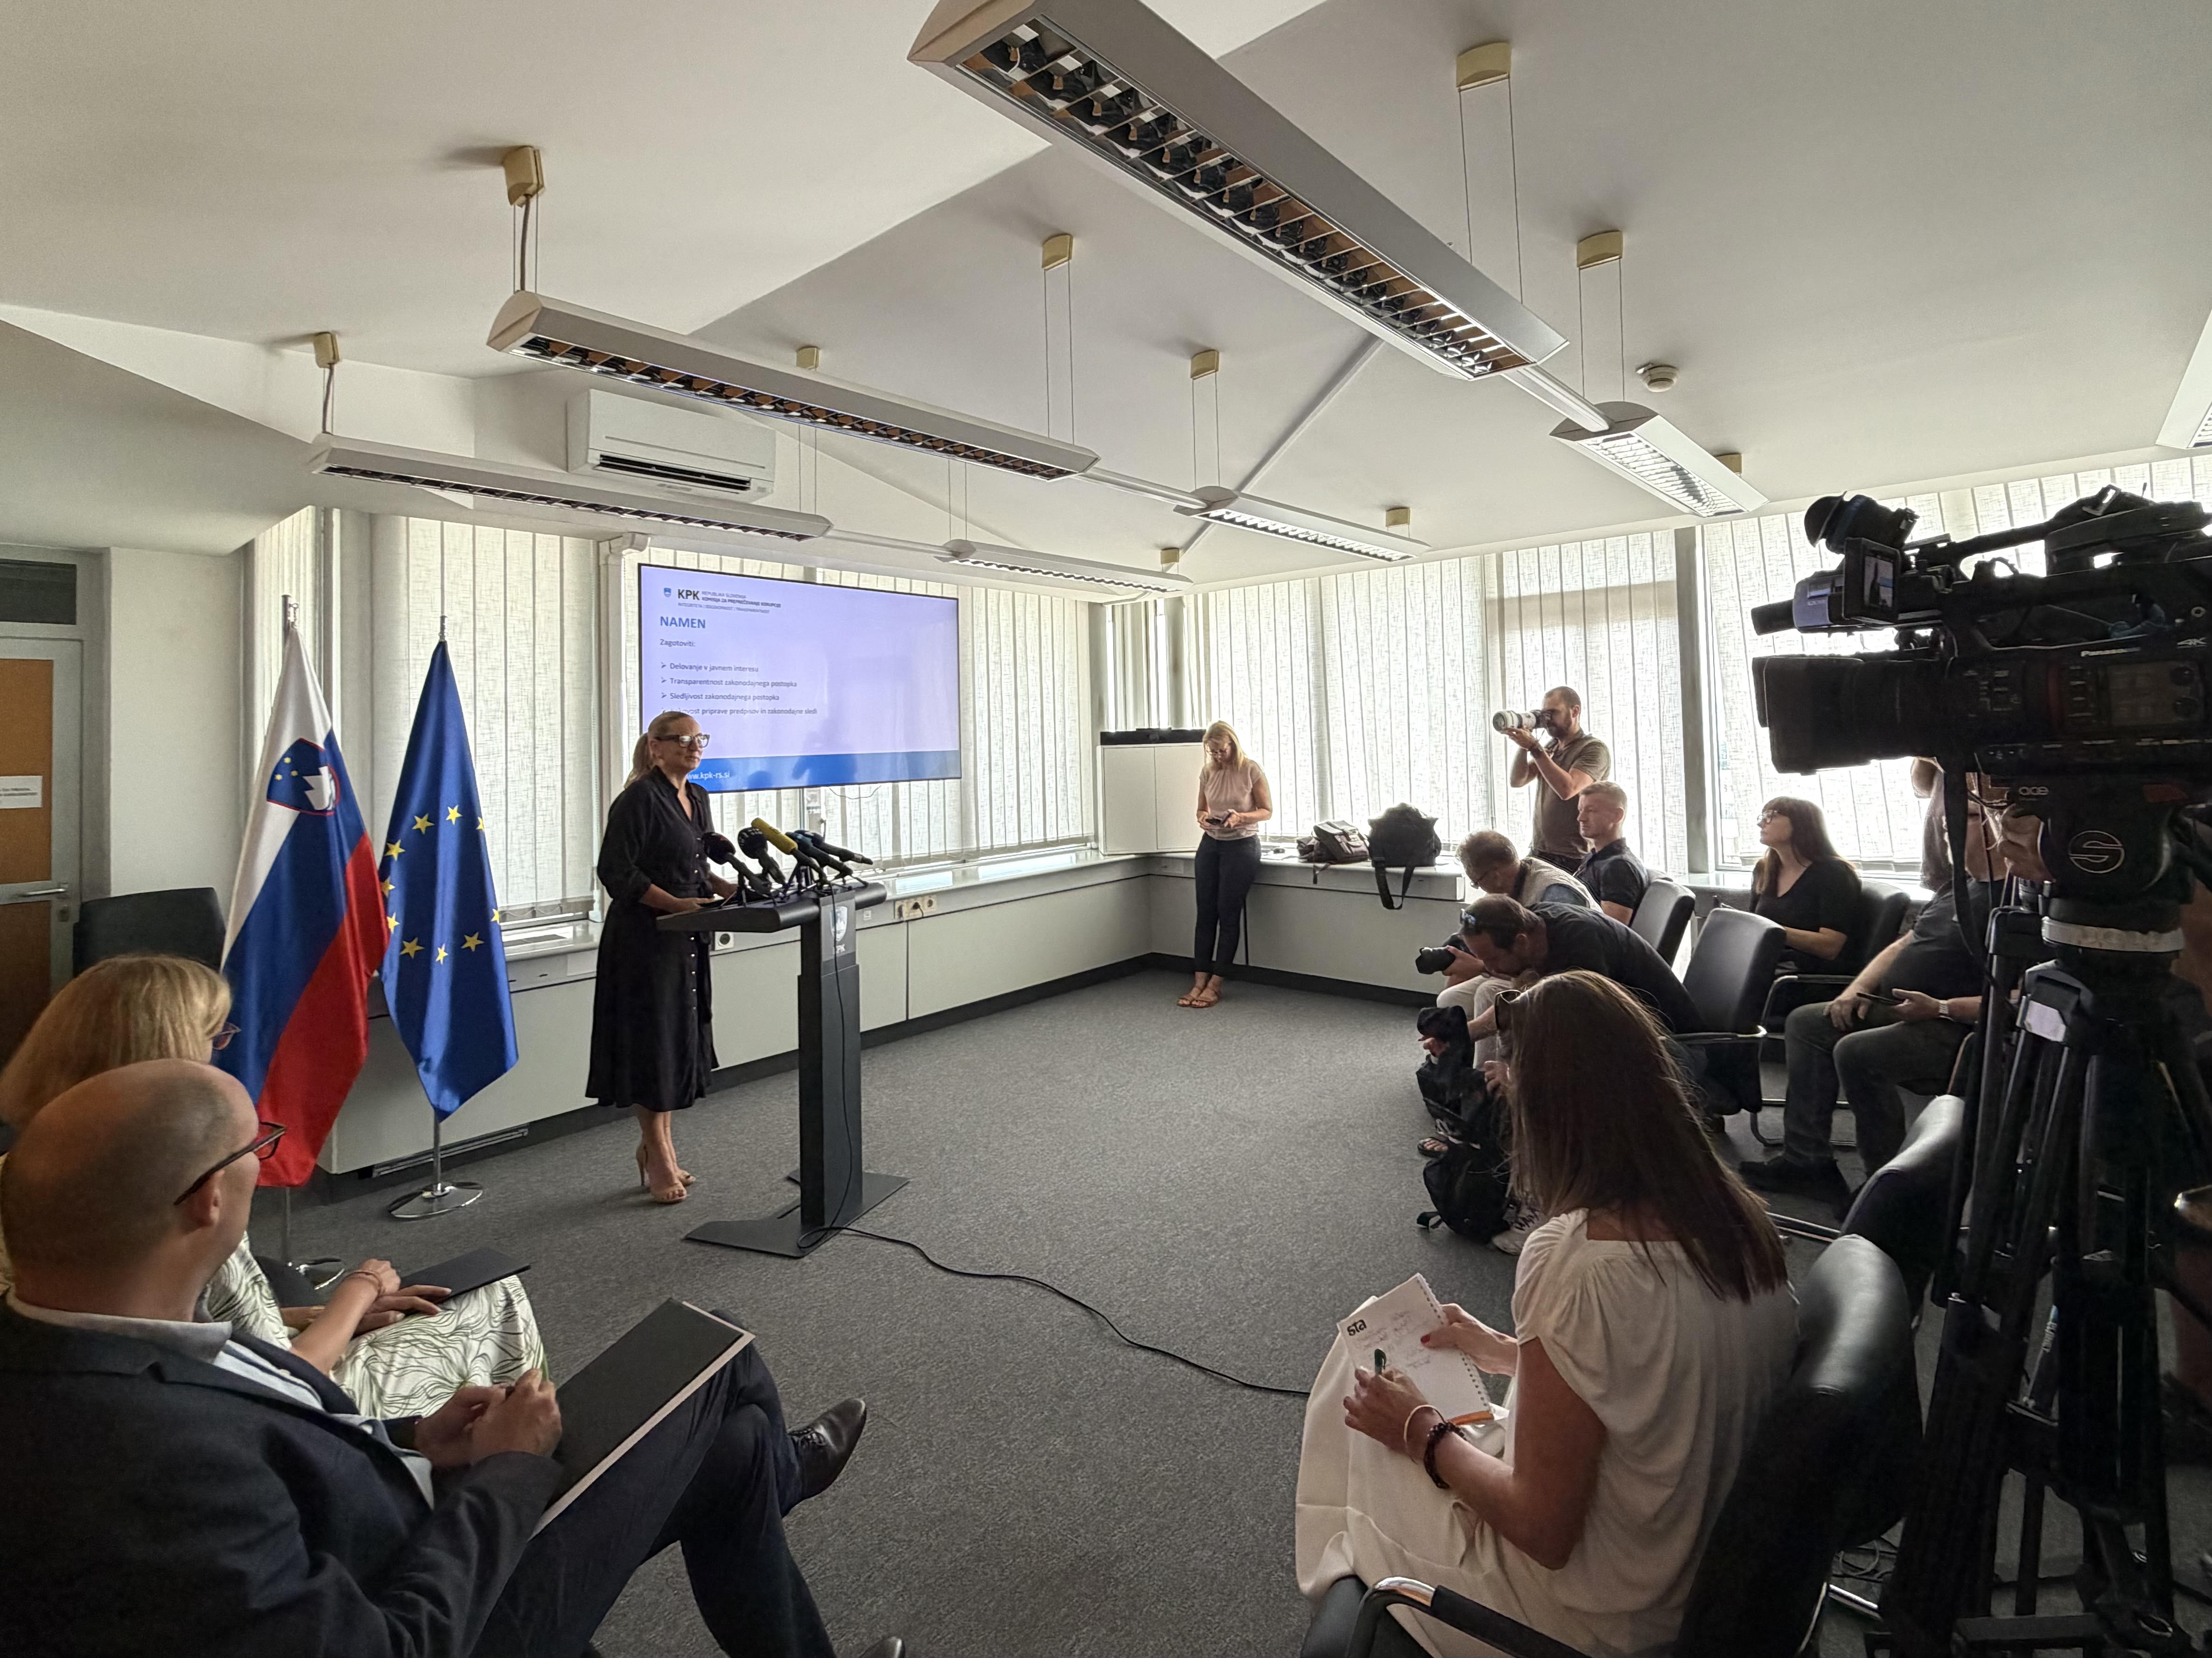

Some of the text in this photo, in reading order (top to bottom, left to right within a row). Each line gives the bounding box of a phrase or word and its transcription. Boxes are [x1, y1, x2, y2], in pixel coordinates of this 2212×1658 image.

[678, 589, 700, 601] KPK
[660, 616, 706, 629] NAMEN
[660, 639, 695, 647] Zagotoviti:
[670, 663, 702, 672] Delovanje
[2019, 786, 2049, 796] ace
[1347, 1319, 1367, 1336] sta
